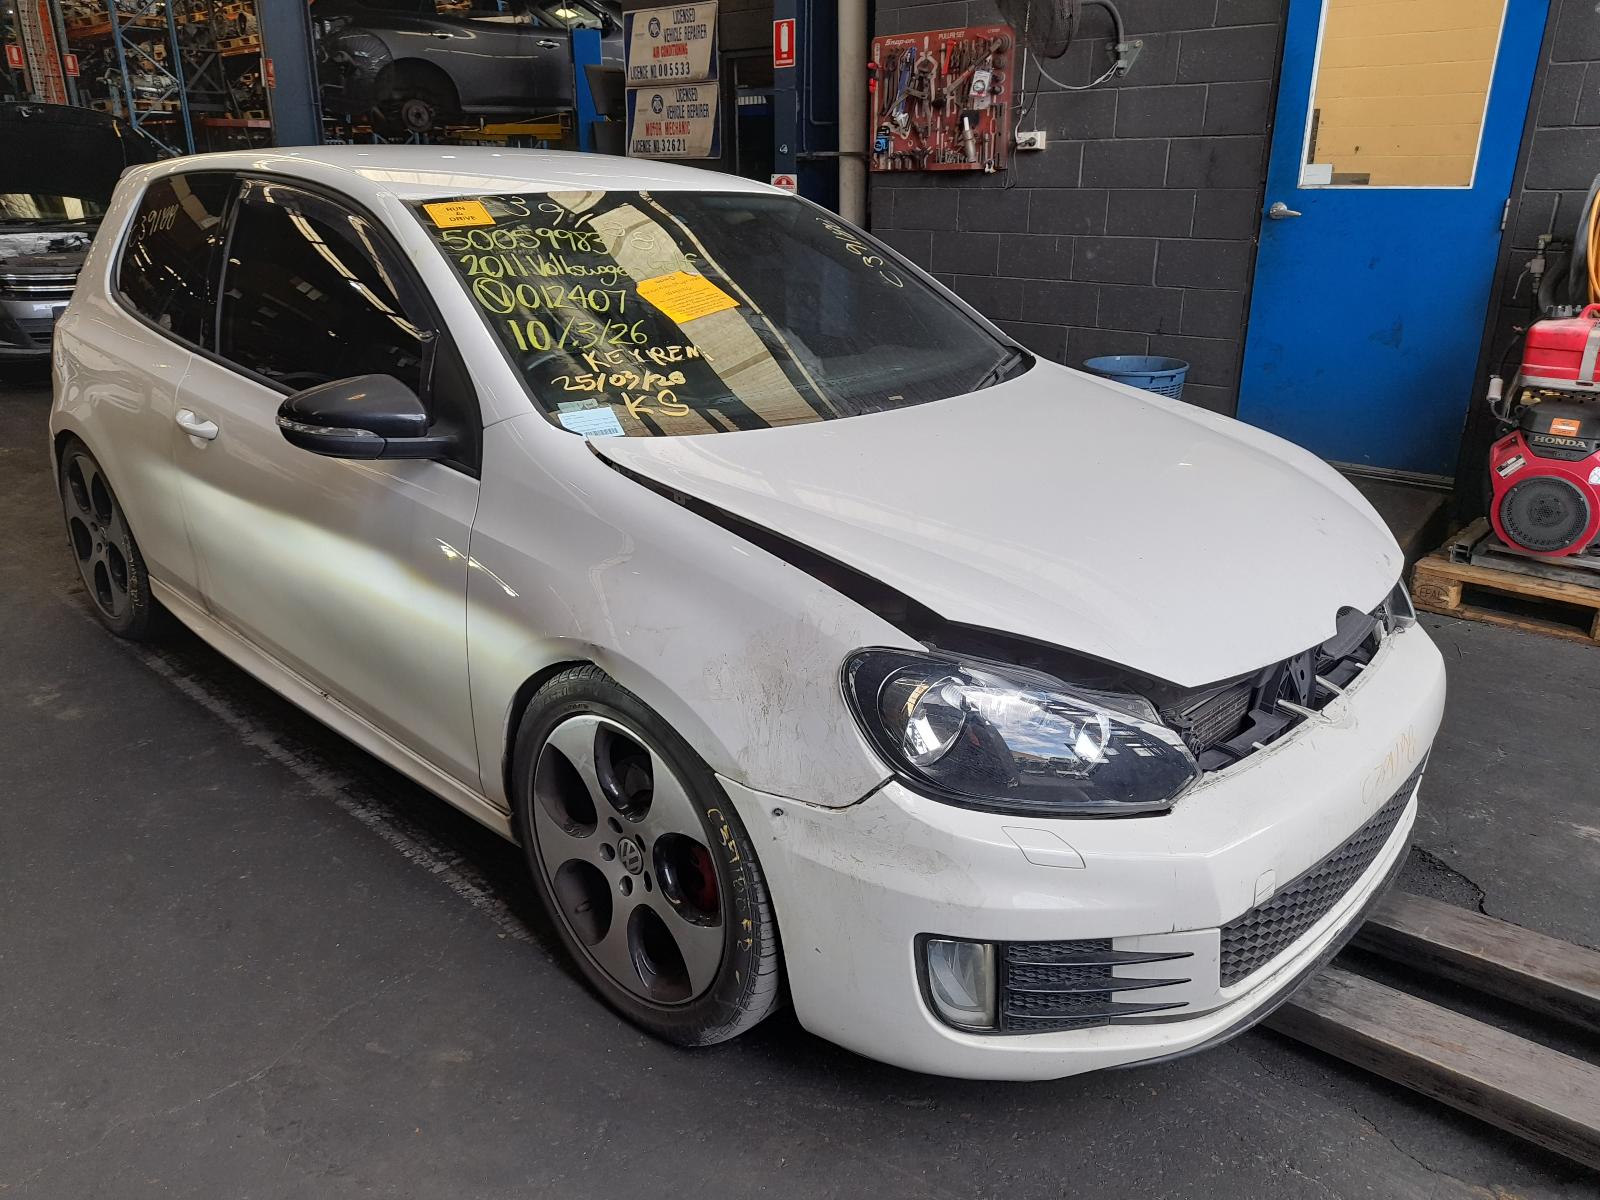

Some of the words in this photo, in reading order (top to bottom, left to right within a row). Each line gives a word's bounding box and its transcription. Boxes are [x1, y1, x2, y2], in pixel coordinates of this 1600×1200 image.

[673, 8, 695, 24] LICENSED
[664, 26, 682, 43] VEHICLE
[684, 24, 707, 41] REPAIRER
[885, 38, 916, 46] Snap-on
[658, 61, 690, 77] 005533
[676, 87, 698, 102] LICENSED
[666, 105, 684, 119] VEHICLE
[686, 103, 709, 118] REPAIRER
[665, 120, 690, 135] MECHANIC
[661, 139, 686, 152] 32621
[442, 228, 608, 254] 50059983
[459, 252, 529, 278] 2011
[1533, 435, 1587, 448] HONDA
